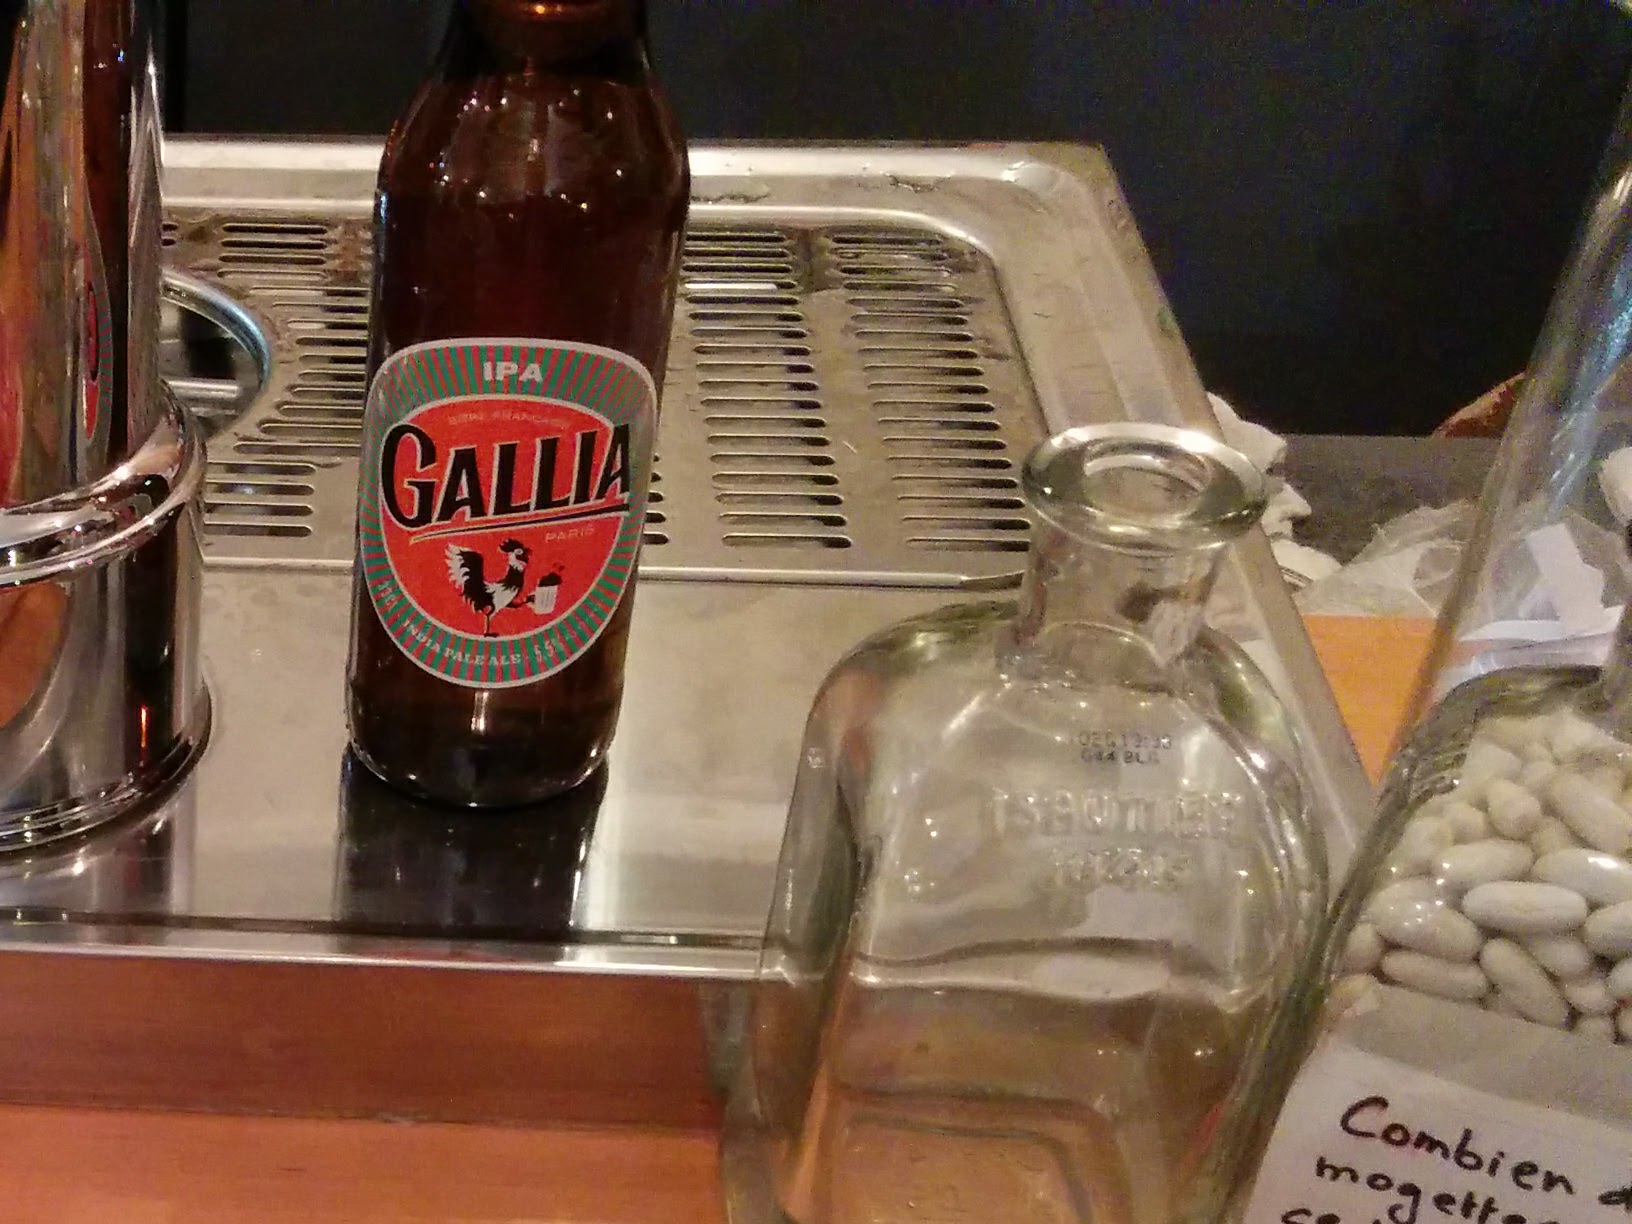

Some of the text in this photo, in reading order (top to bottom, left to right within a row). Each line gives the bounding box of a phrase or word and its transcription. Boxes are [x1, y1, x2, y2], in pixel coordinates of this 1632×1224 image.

[482, 360, 543, 383] IPA
[379, 423, 630, 529] GALLIA
[1340, 1095, 1575, 1195] Combien
